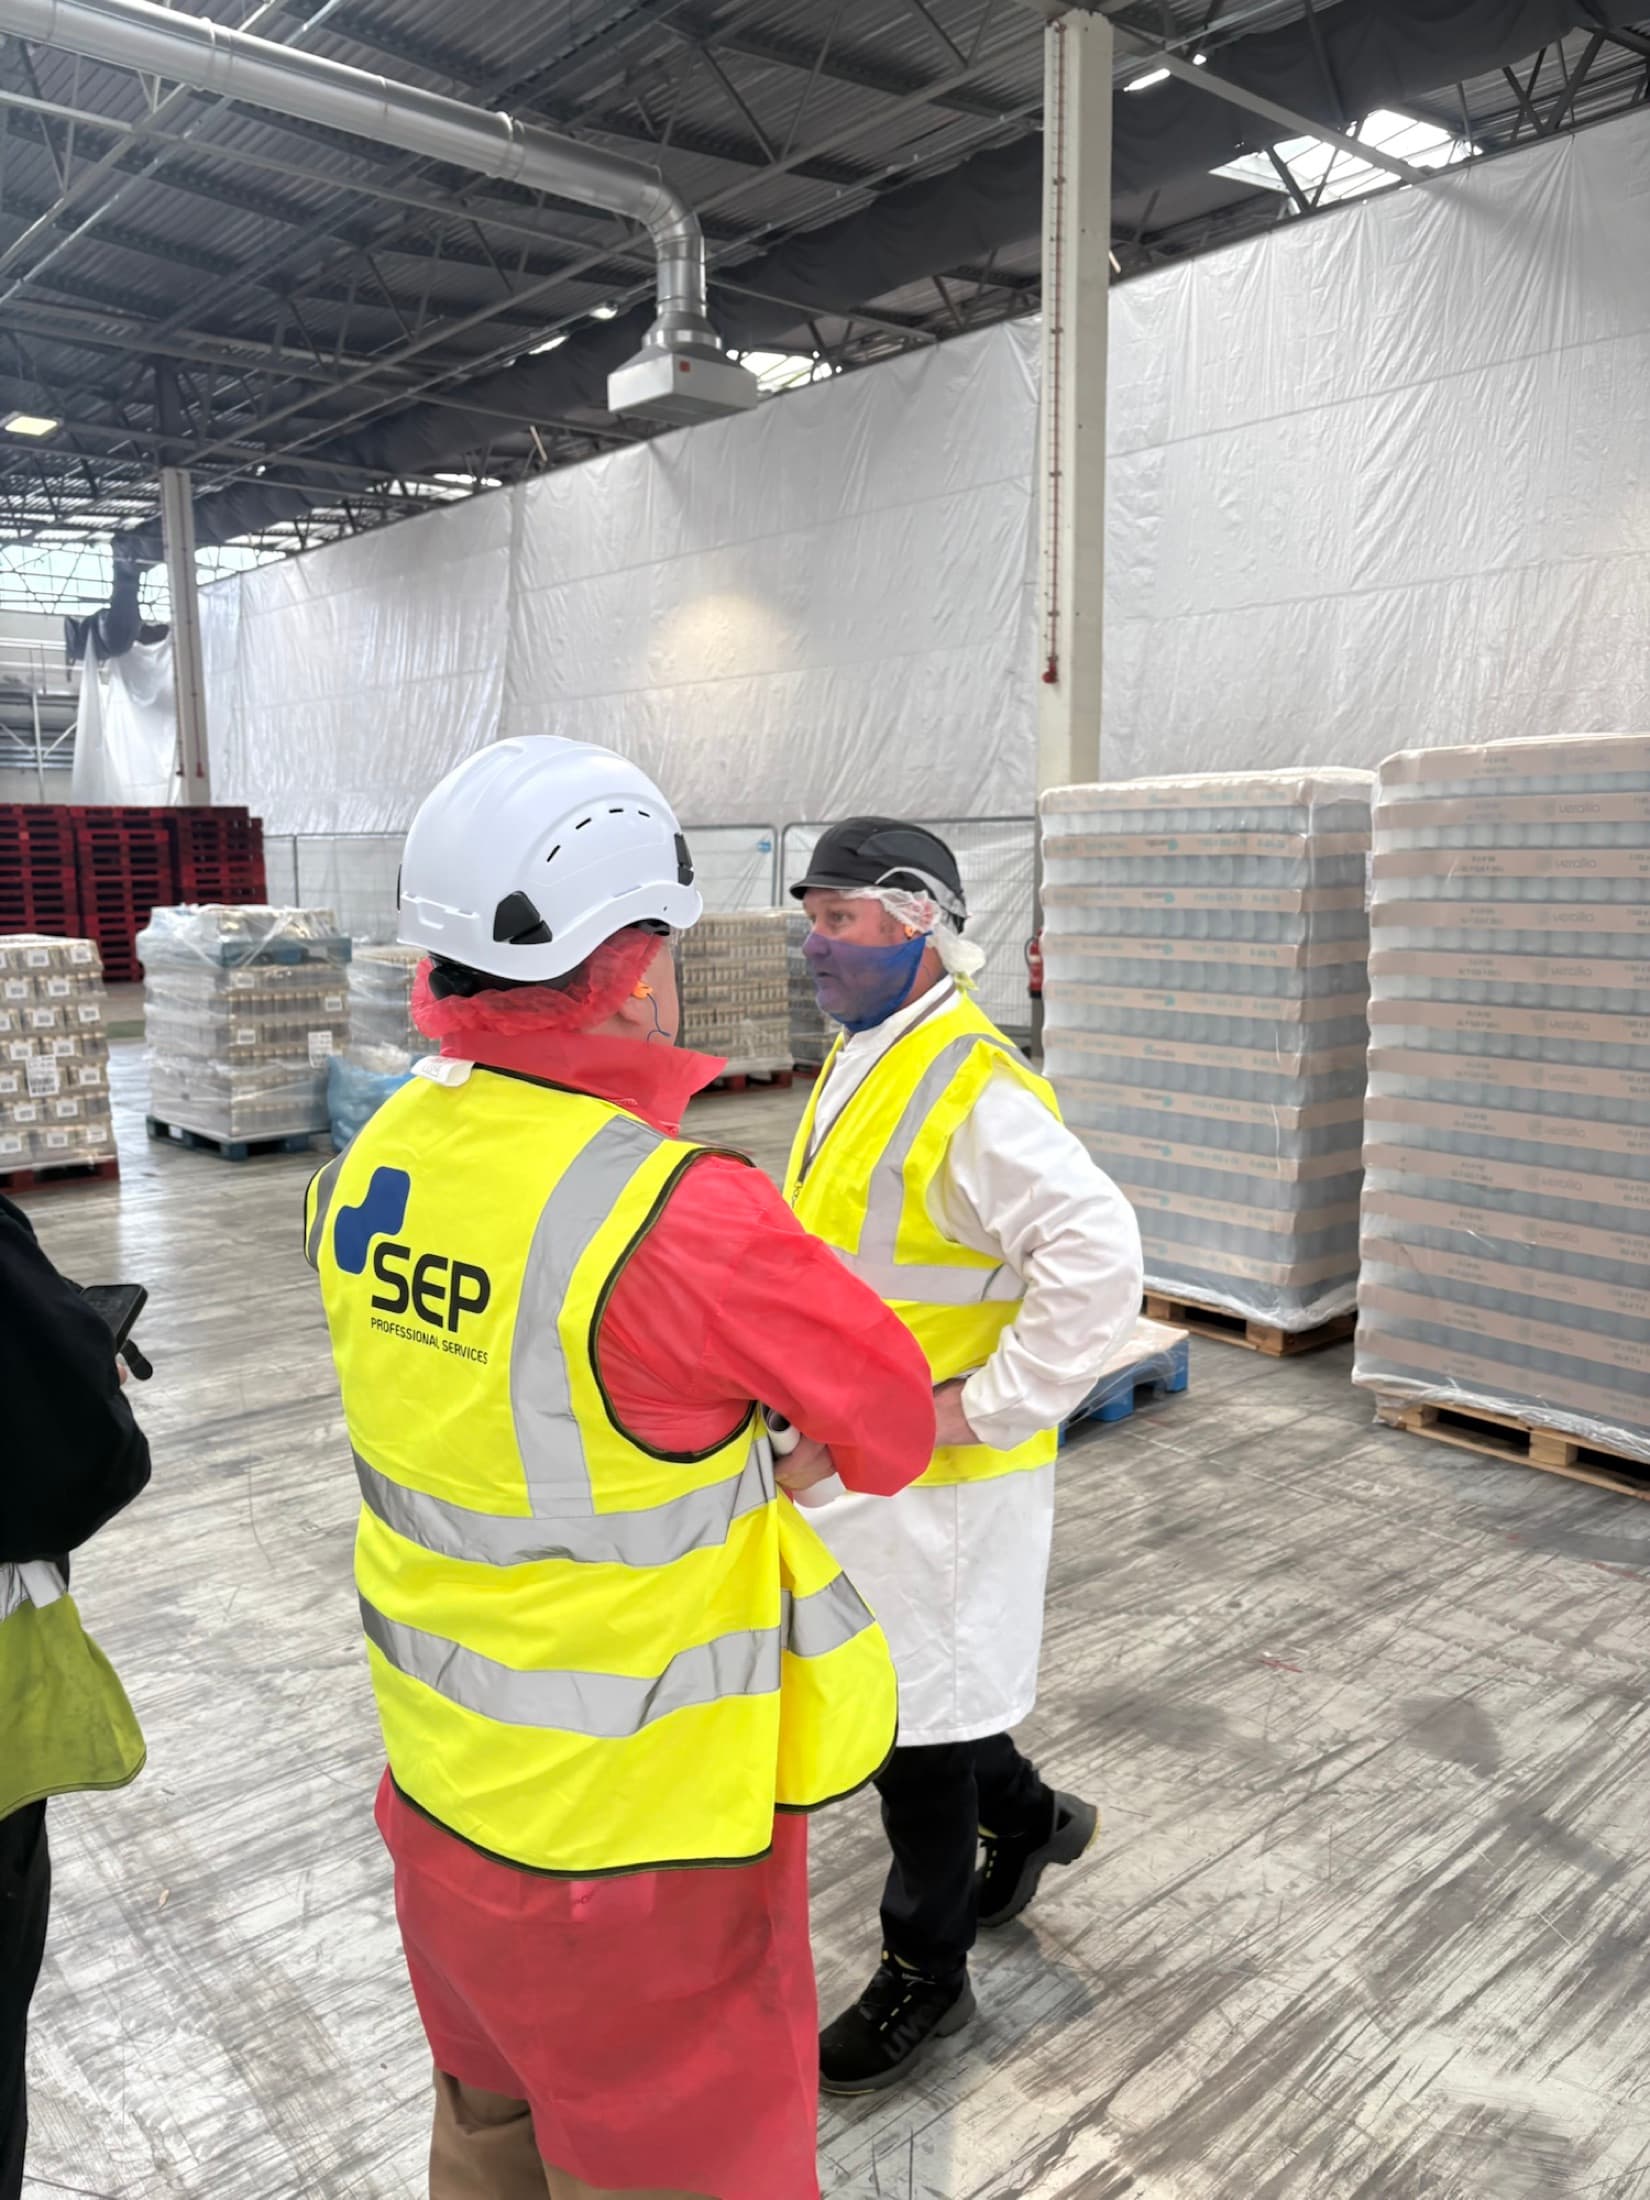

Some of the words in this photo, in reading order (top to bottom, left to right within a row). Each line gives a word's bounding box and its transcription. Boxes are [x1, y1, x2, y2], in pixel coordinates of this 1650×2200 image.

[371, 1241, 491, 1333] SEP
[370, 1317, 440, 1350] PROFESSIONAL
[441, 1339, 489, 1365] SERVICES
